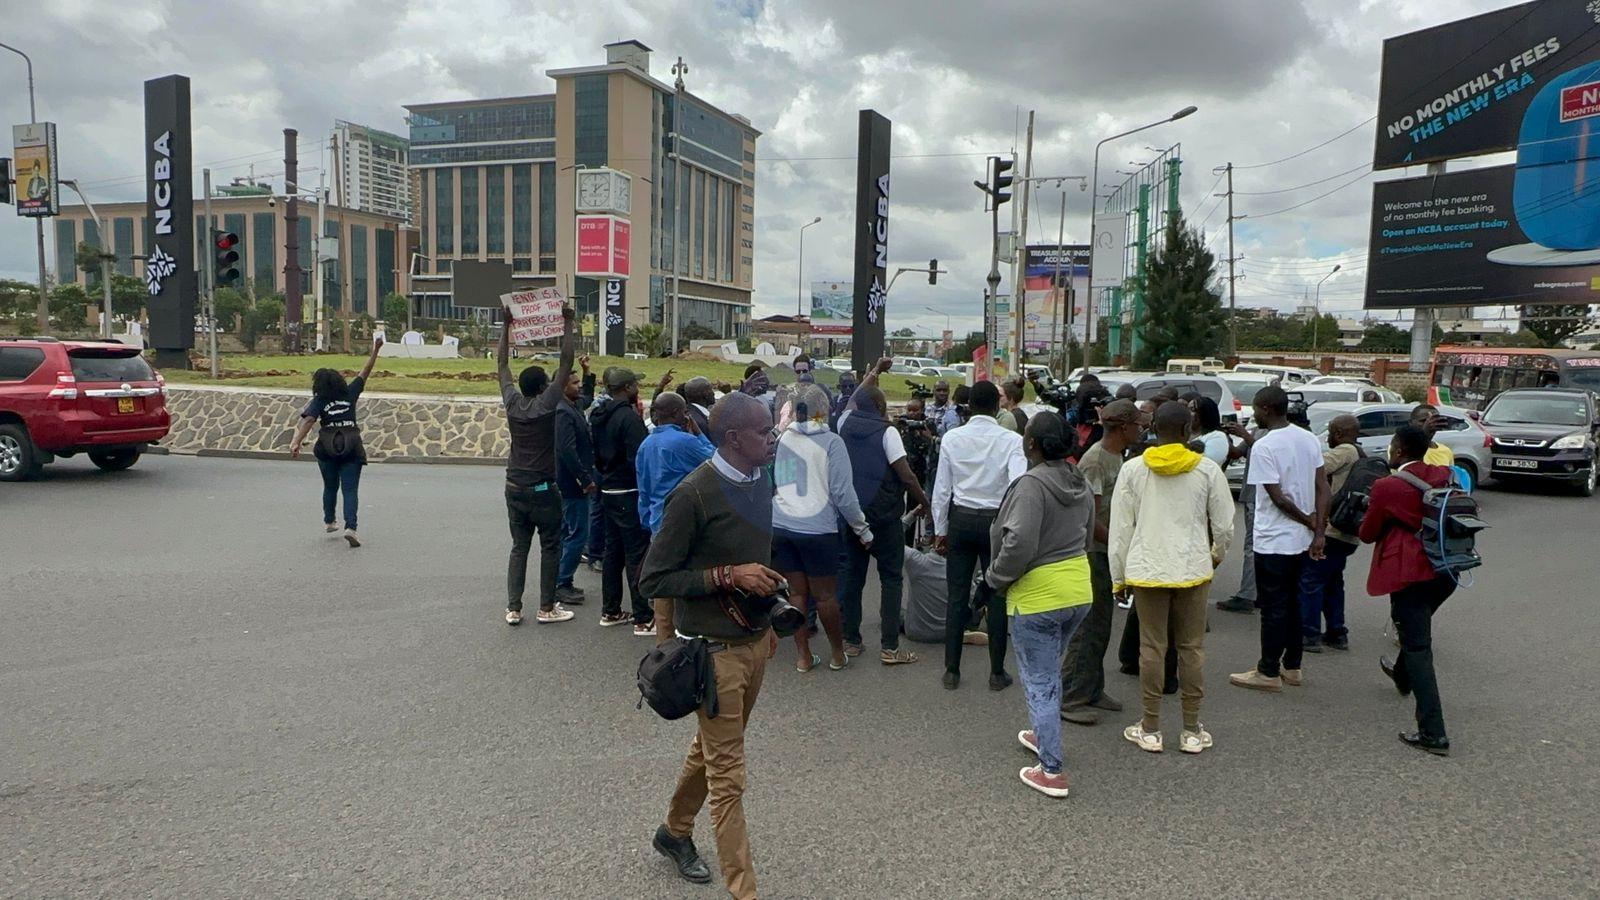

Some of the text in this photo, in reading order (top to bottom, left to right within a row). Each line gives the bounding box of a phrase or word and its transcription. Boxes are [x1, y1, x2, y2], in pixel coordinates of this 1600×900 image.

[1387, 36, 1560, 139] NO MONTHLY FEES
[1582, 88, 1600, 105] N
[1409, 71, 1535, 144] THE NEW ERA
[1563, 104, 1600, 118] MONTH
[154, 130, 171, 234] NCBA
[1384, 201, 1422, 211] Welcome
[1423, 199, 1432, 207] to
[1435, 198, 1448, 206] the
[1471, 193, 1487, 201] era
[875, 173, 889, 268] NCBA
[1383, 213, 1392, 222] of
[1405, 210, 1439, 220] monthly
[1441, 208, 1455, 216] fee
[1382, 229, 1404, 238] Open
[1417, 225, 1442, 234] NCBA
[1443, 222, 1480, 232] account
[553, 289, 561, 298] A
[608, 279, 620, 306] NC
[521, 300, 564, 315] PROOF THAT
[512, 315, 546, 329] PRAYERS
